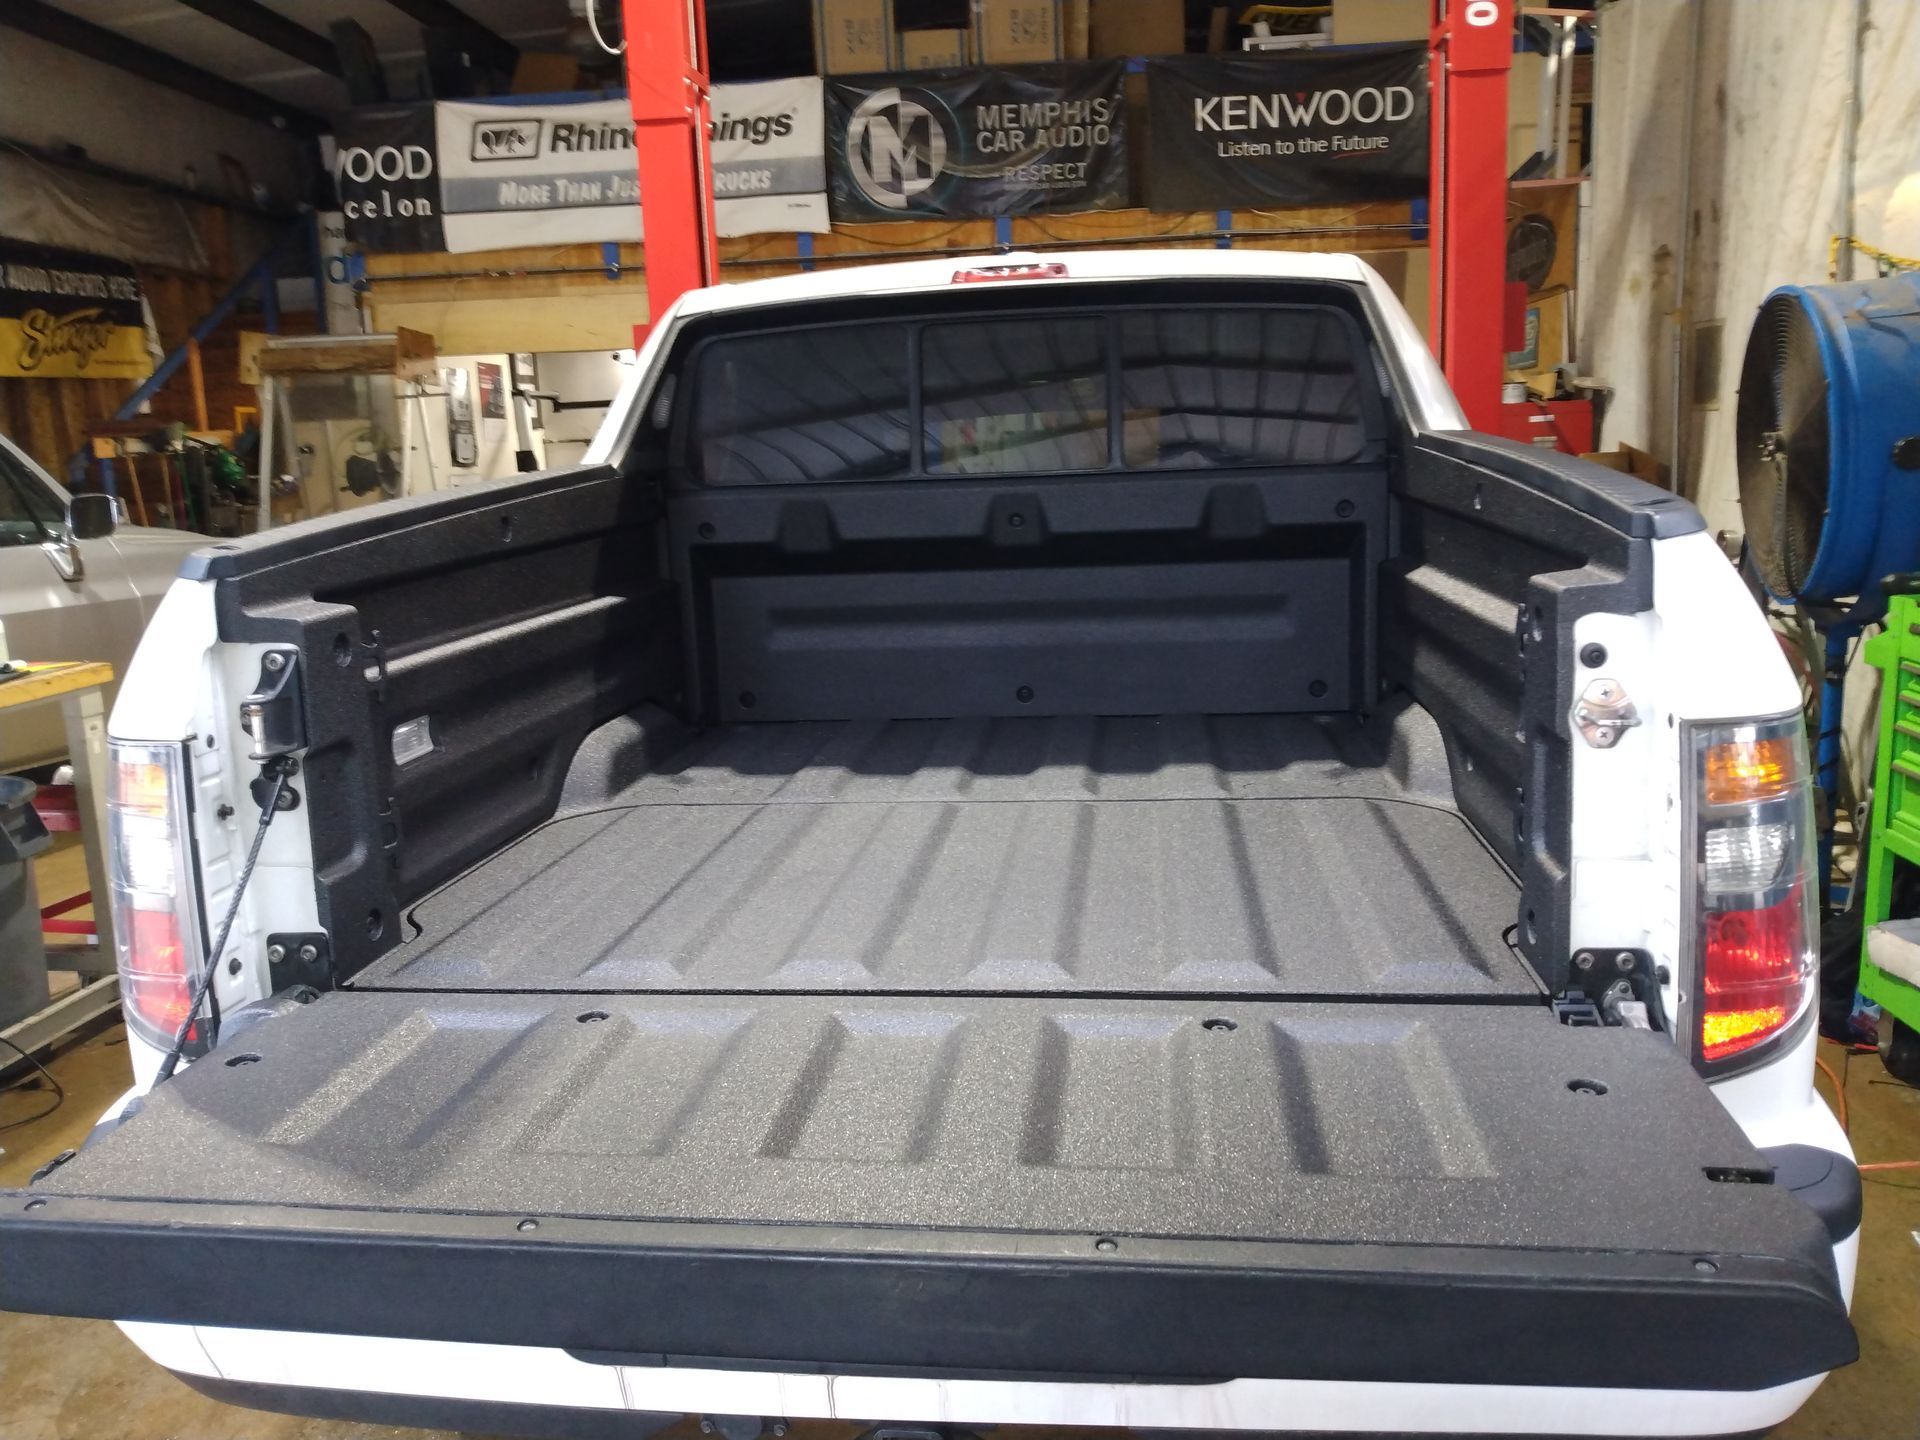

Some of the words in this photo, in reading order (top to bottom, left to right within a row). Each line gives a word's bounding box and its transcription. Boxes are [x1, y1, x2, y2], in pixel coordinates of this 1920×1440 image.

[975, 97, 1110, 131] MEMPHIS
[1194, 86, 1415, 132] KENWOOD
[551, 122, 637, 154] Rhin
[976, 130, 1026, 153] CAR
[1032, 124, 1111, 149] AUDIO
[1217, 140, 1271, 158] Listen
[1275, 139, 1295, 155] to
[1299, 136, 1329, 153] the
[1331, 135, 1391, 151] Future
[605, 175, 641, 200] JUS
[714, 169, 773, 192] RUCKS
[1003, 162, 1088, 182] RESPECT
[343, 189, 433, 220] celon
